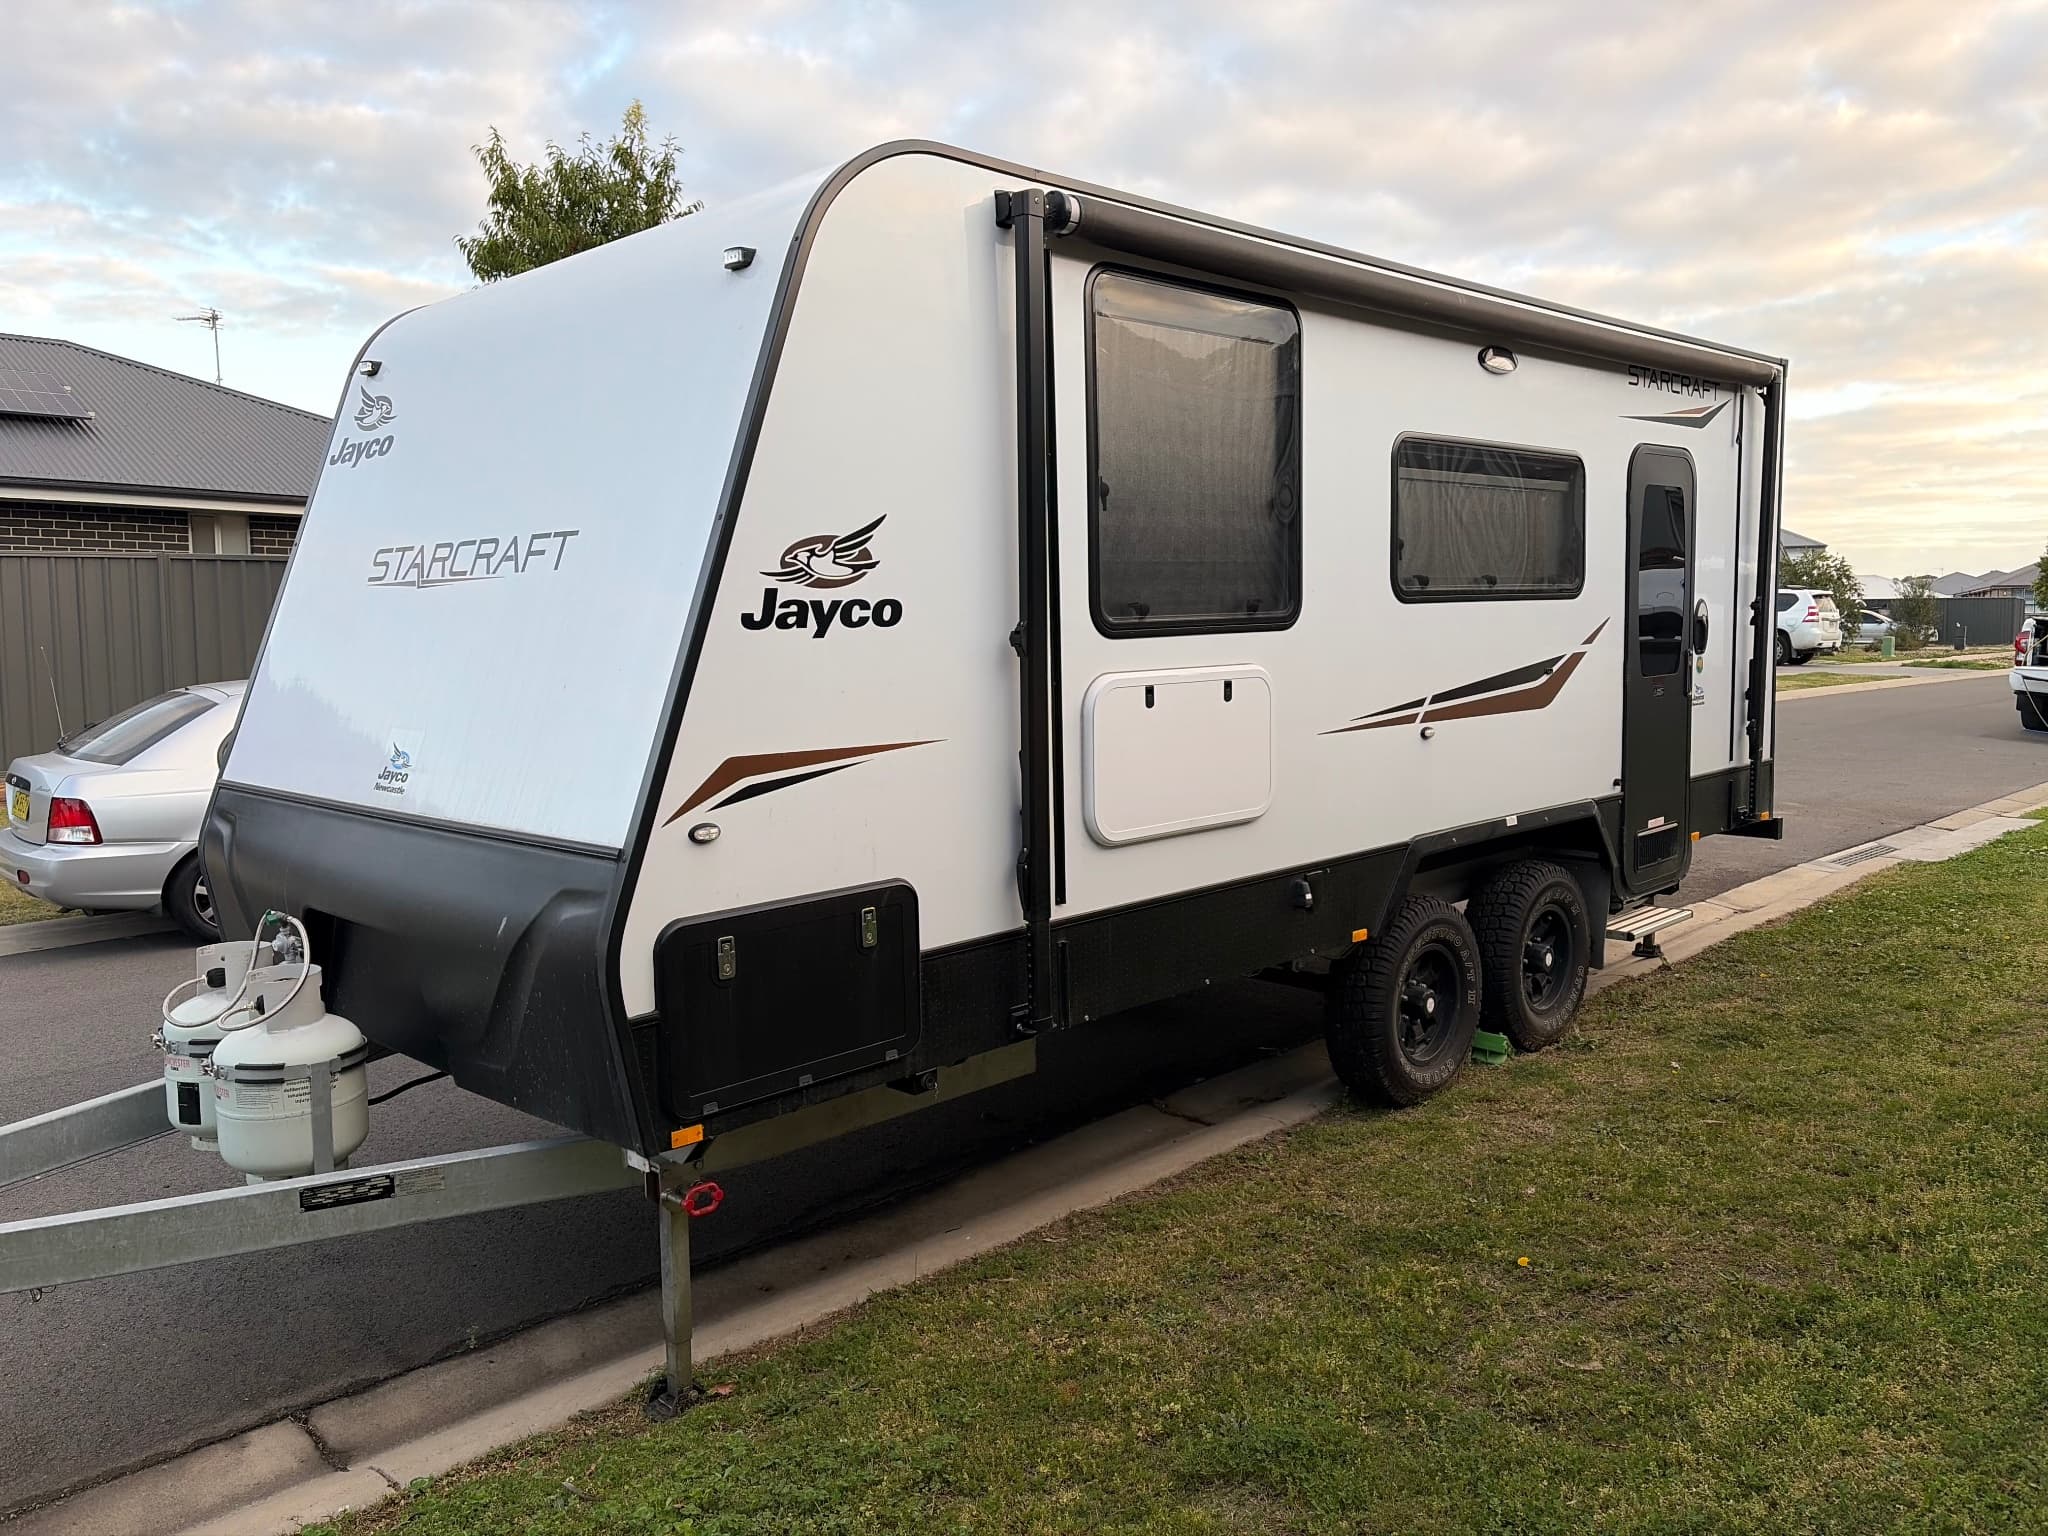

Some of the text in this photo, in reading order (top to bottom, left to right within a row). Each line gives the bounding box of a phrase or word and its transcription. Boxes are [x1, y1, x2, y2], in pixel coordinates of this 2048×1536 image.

[1627, 364, 1721, 402] STARCRAFT
[329, 434, 395, 469] Jayco
[367, 529, 580, 590] STARCRAFT
[740, 587, 903, 639] Jayco
[377, 766, 409, 784] Jayco
